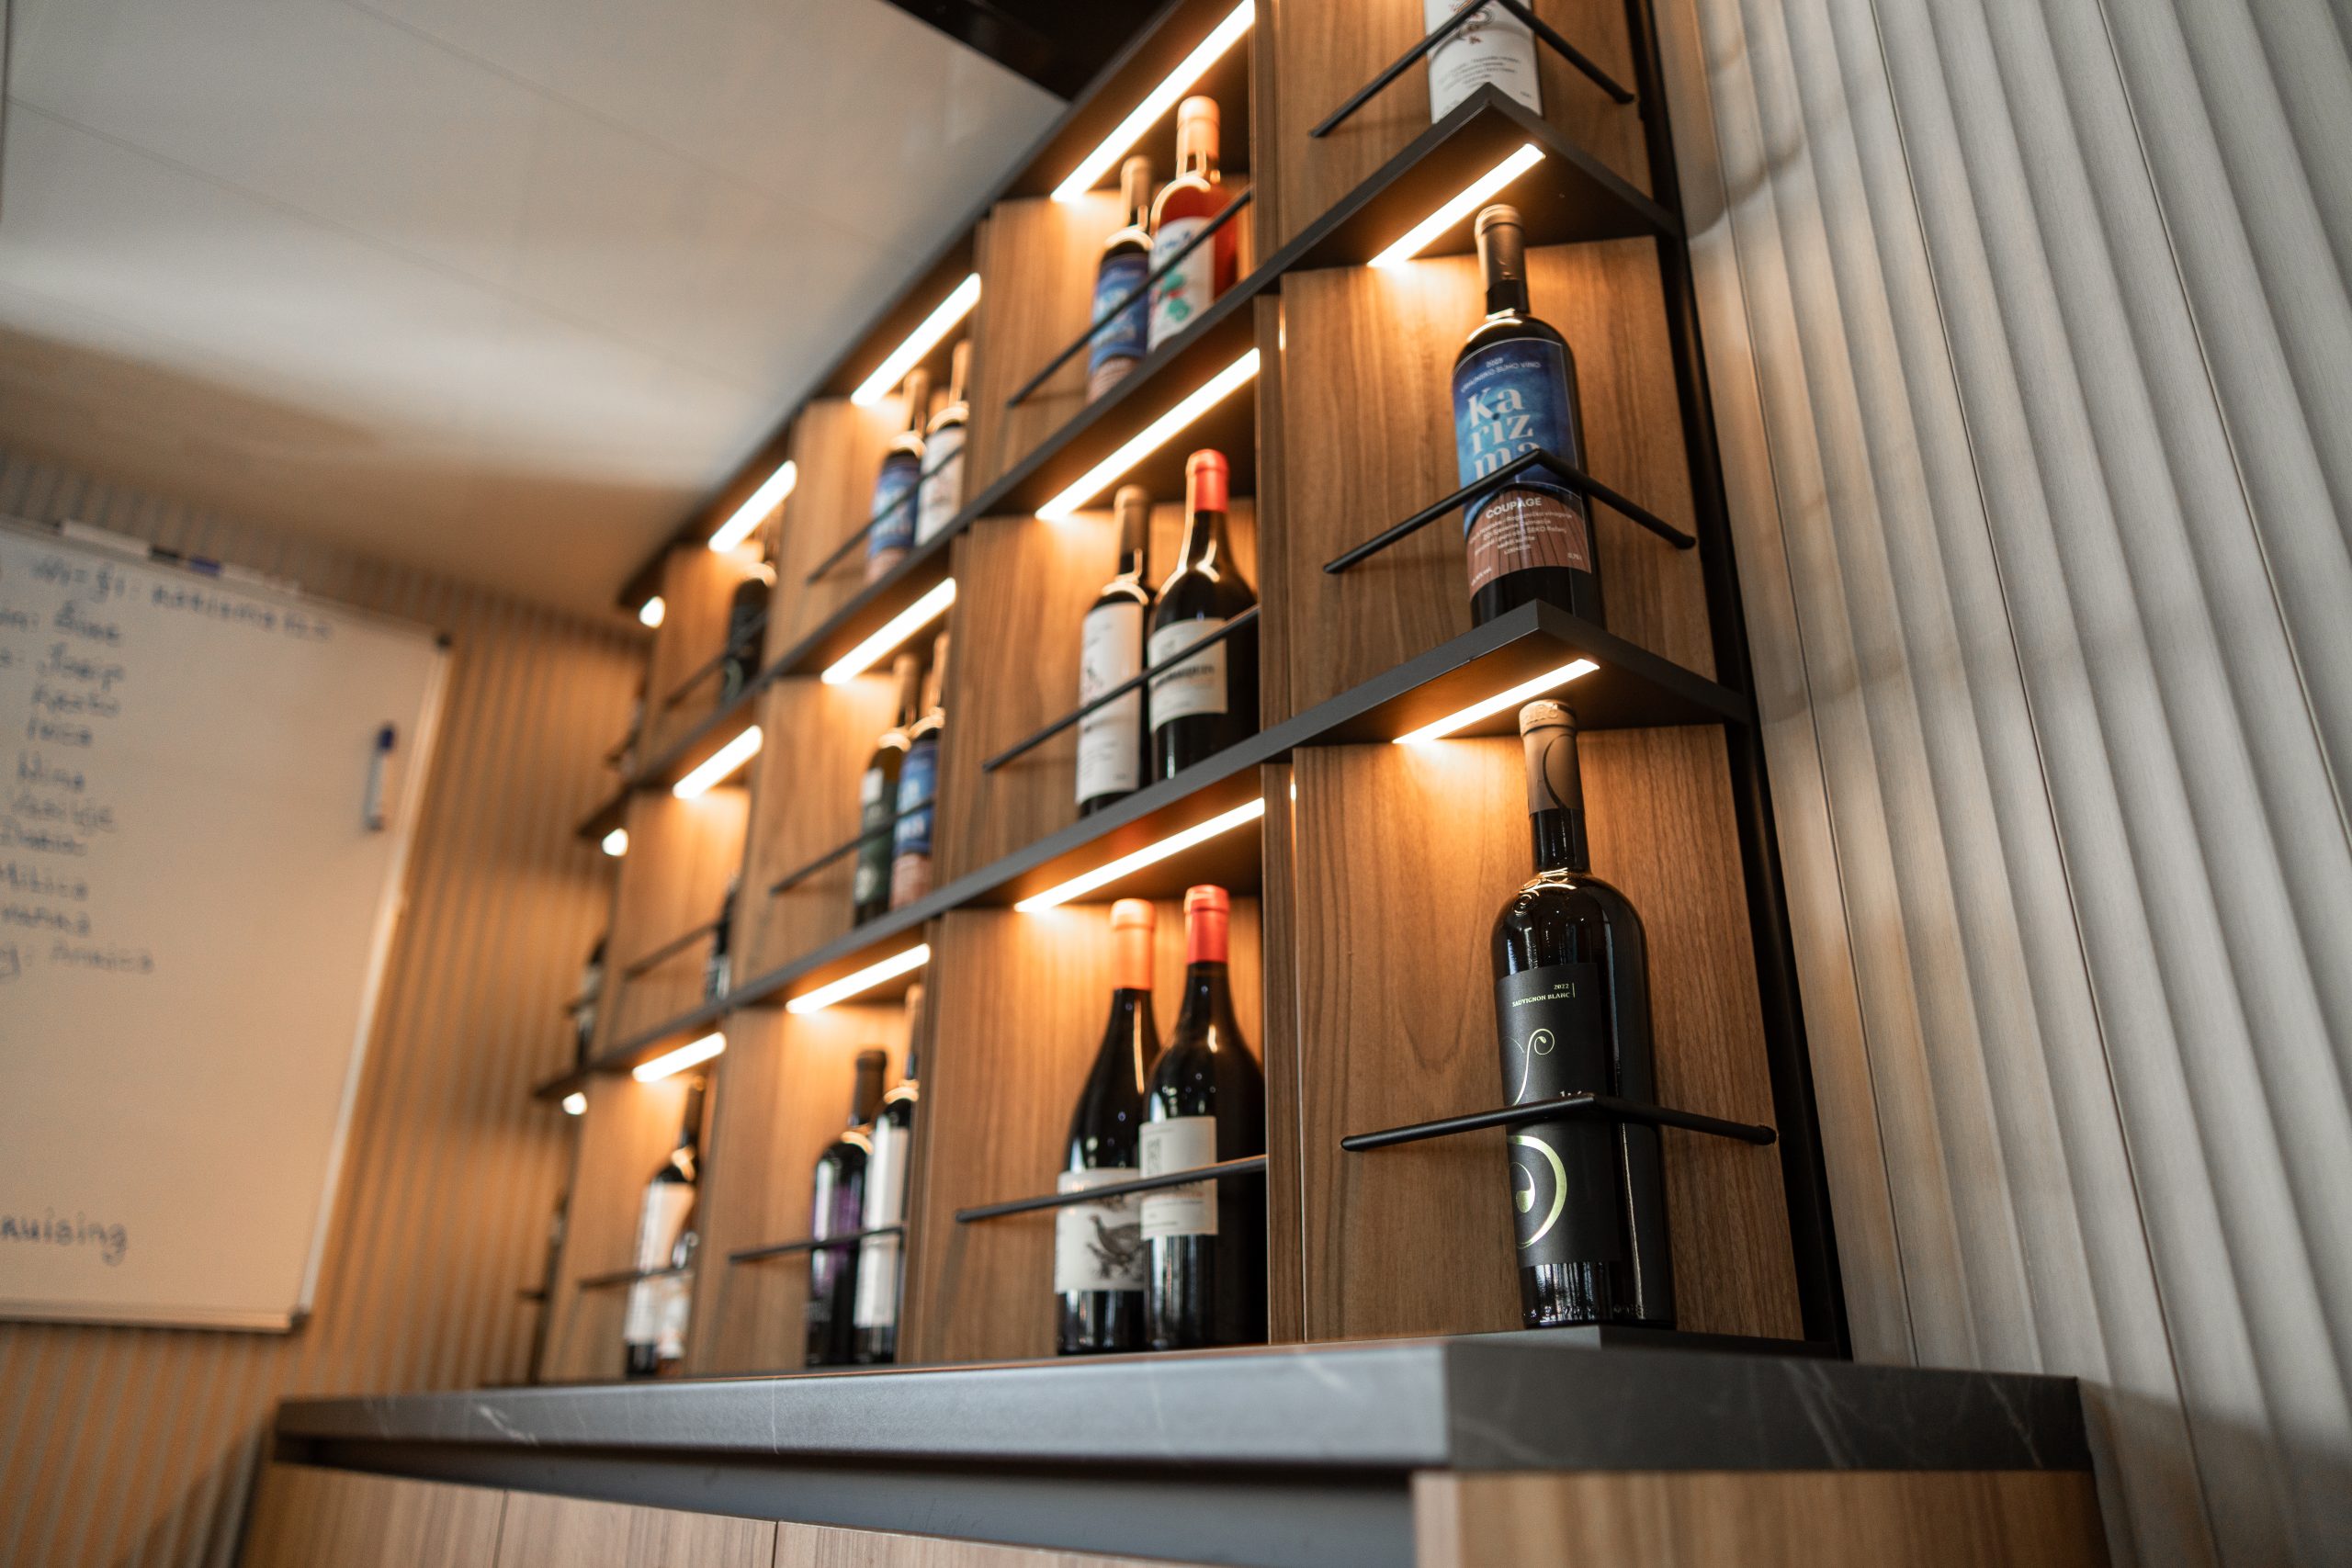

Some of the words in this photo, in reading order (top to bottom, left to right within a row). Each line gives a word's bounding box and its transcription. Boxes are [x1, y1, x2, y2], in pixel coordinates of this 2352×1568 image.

[1468, 387, 1525, 428] Ka
[1470, 414, 1533, 456] riz
[1486, 497, 1542, 519] COUPAGE
[1512, 994, 1546, 1008] SAUVIGNON
